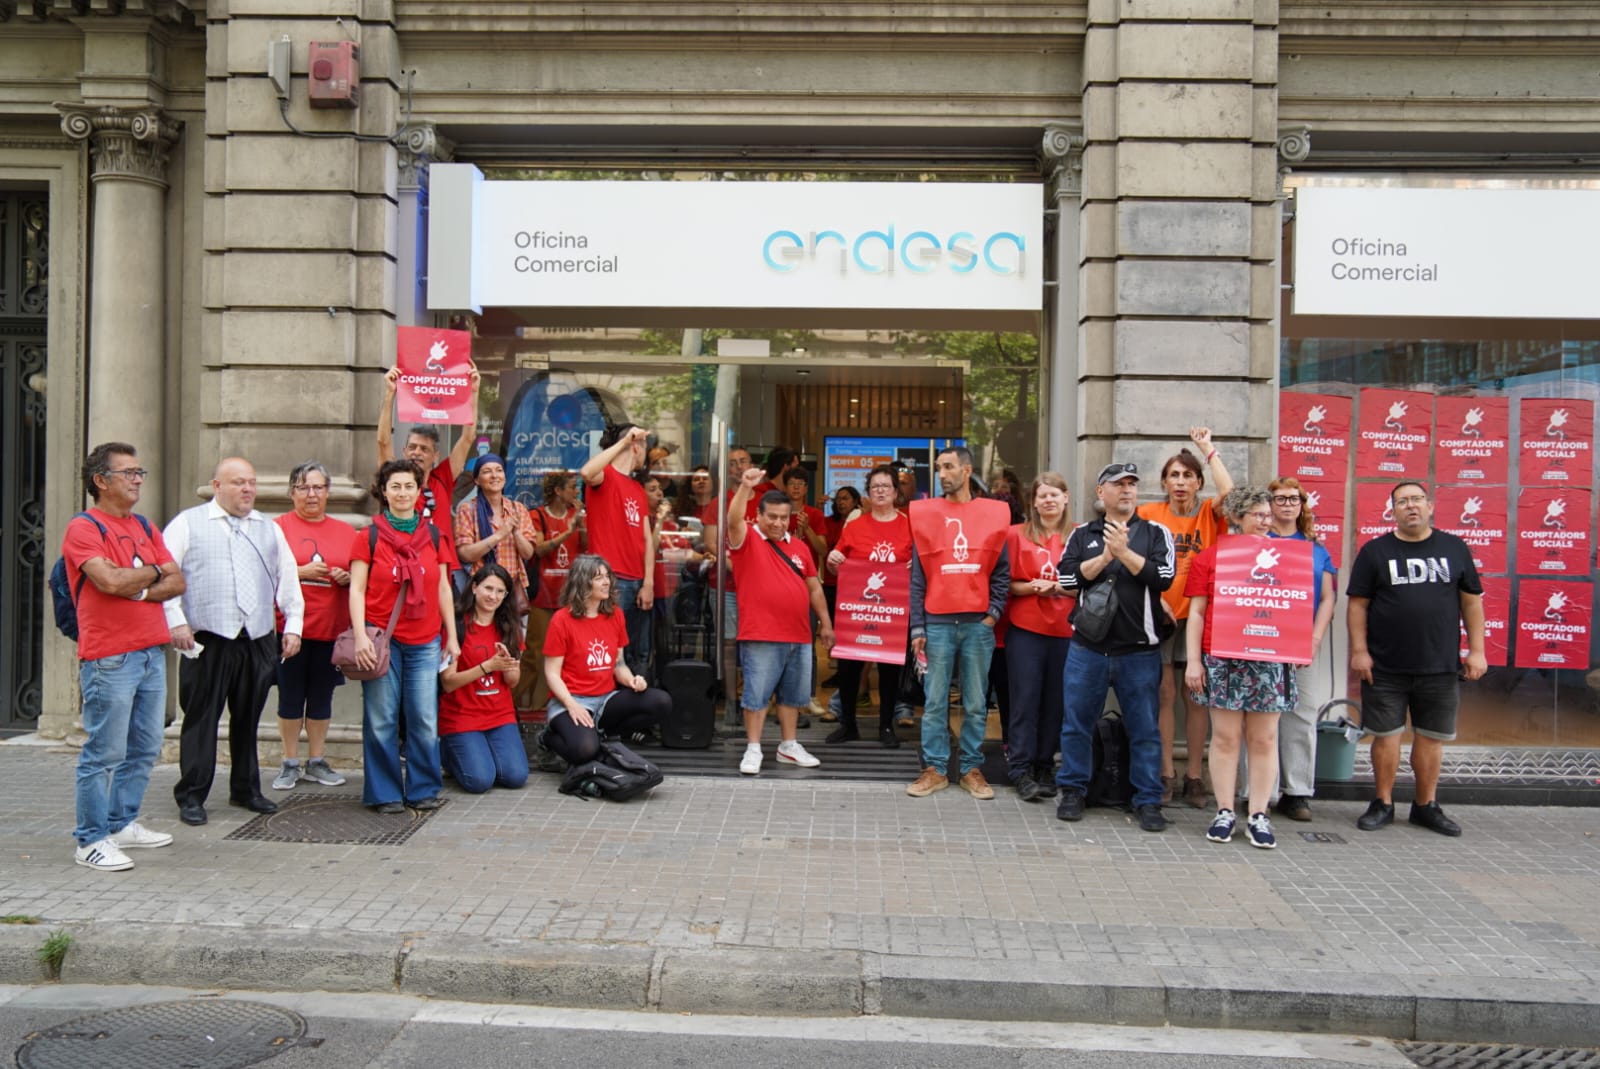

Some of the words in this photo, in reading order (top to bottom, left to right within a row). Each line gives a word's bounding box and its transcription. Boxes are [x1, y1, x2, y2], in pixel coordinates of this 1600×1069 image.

[514, 231, 588, 249] Oficina
[763, 221, 1026, 273] endesa
[1331, 238, 1407, 256] Oficina
[514, 255, 618, 273] Comercial
[1331, 263, 1438, 281] Comercial
[400, 375, 468, 387] COMPTADORS
[414, 386, 456, 395] SOCIALS
[1281, 435, 1345, 447] COMPTADORS
[1362, 431, 1426, 443] COMPTADORS
[1292, 445, 1332, 455] SOCIALS
[1373, 441, 1413, 451] SOCIALS
[1439, 440, 1504, 449] COMPTADORS
[1523, 441, 1589, 450] COMPTADORS
[1452, 448, 1492, 457] SOCIALS
[1536, 449, 1576, 458] SOCIALS
[1521, 530, 1585, 540] COMPTADORS
[1533, 540, 1573, 548] SOCIALS
[1388, 557, 1450, 585] LDN
[1219, 586, 1308, 600] COMPTADORS
[1235, 597, 1290, 609] SOCIALS
[839, 603, 905, 615] COMPTADORS
[851, 613, 892, 623] SOCIALS
[1521, 622, 1585, 633] COMPTADORS
[1533, 632, 1573, 641] SOCIALS
